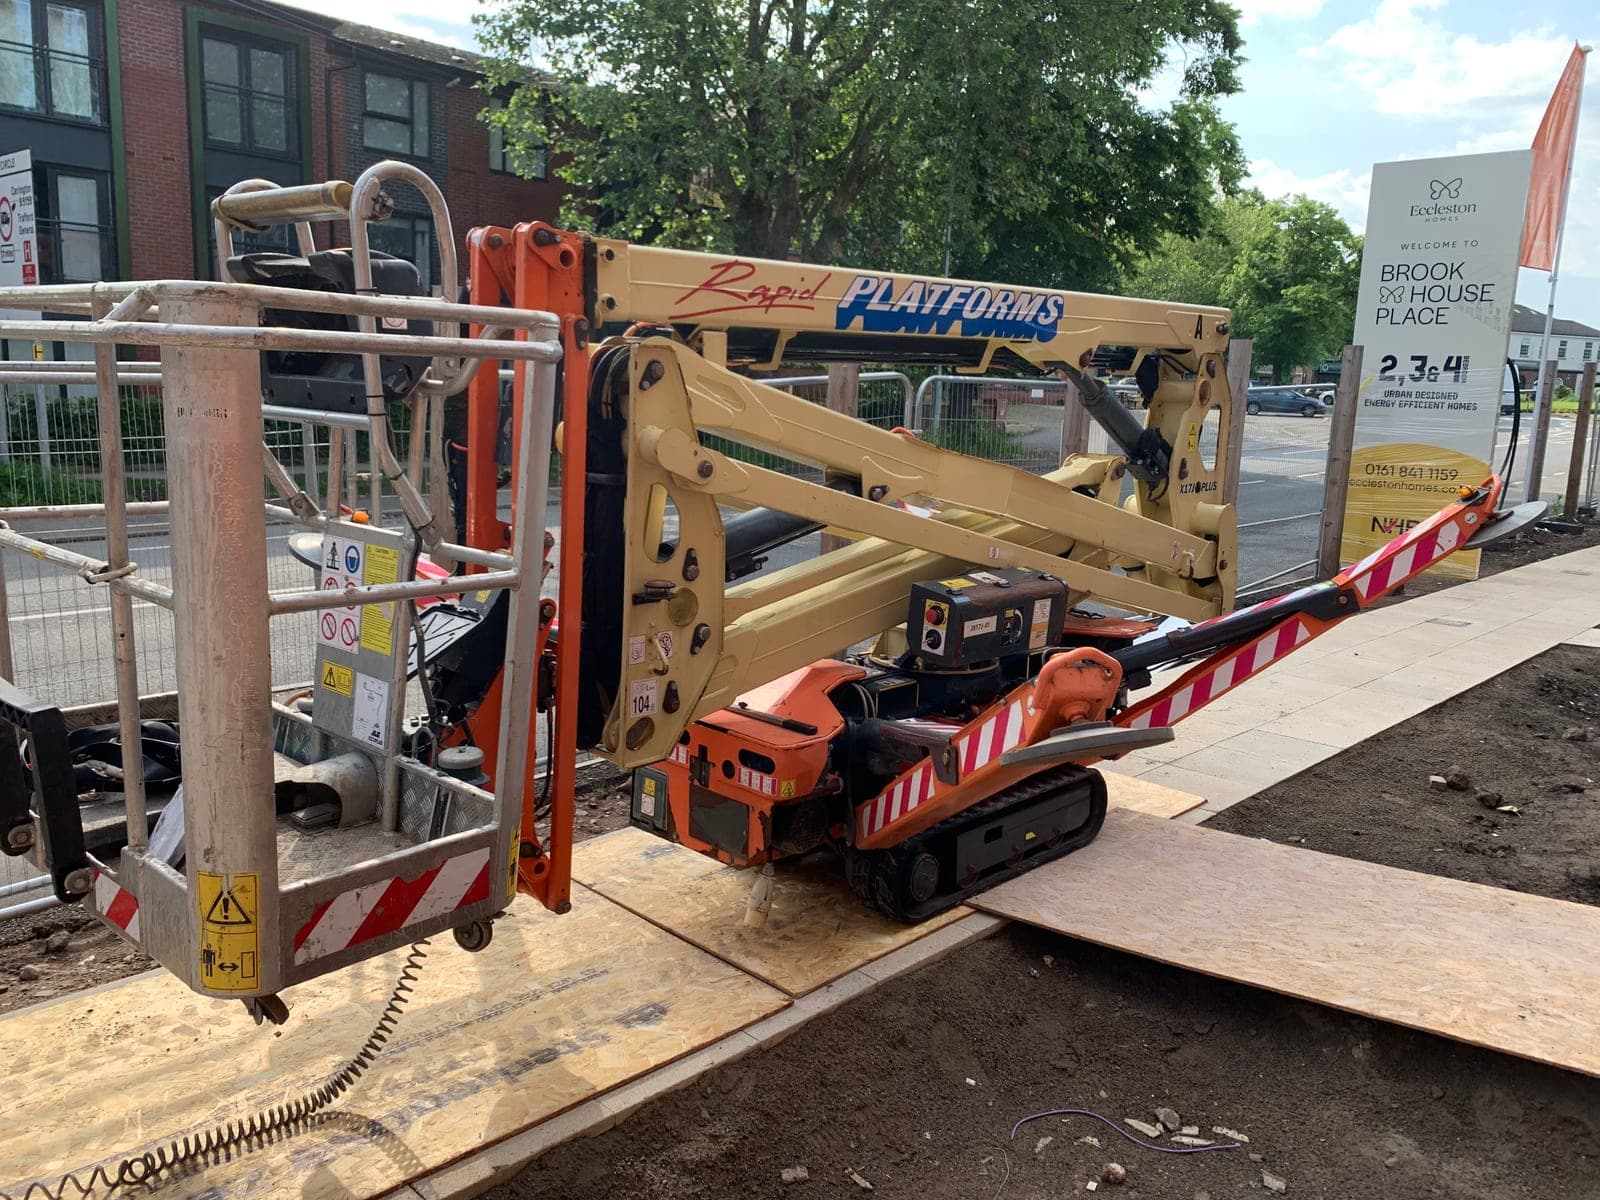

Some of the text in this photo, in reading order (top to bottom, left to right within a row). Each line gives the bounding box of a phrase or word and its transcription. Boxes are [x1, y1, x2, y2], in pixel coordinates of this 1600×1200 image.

[1410, 203, 1477, 217] Eccleston
[1400, 239, 1479, 251] WELCOME TO
[1381, 261, 1466, 283] BROOK
[673, 259, 1064, 328] Rapid PLATFORMS
[1410, 283, 1496, 304] HOUSE
[1375, 306, 1450, 326] PLACE
[1194, 314, 1203, 340] A
[1364, 399, 1478, 411] ENERGY EFFICIENT HOMES
[1384, 390, 1459, 401] URBAN DESIGNED
[1365, 463, 1459, 481] 0161 841 1159
[633, 695, 650, 714] 104
